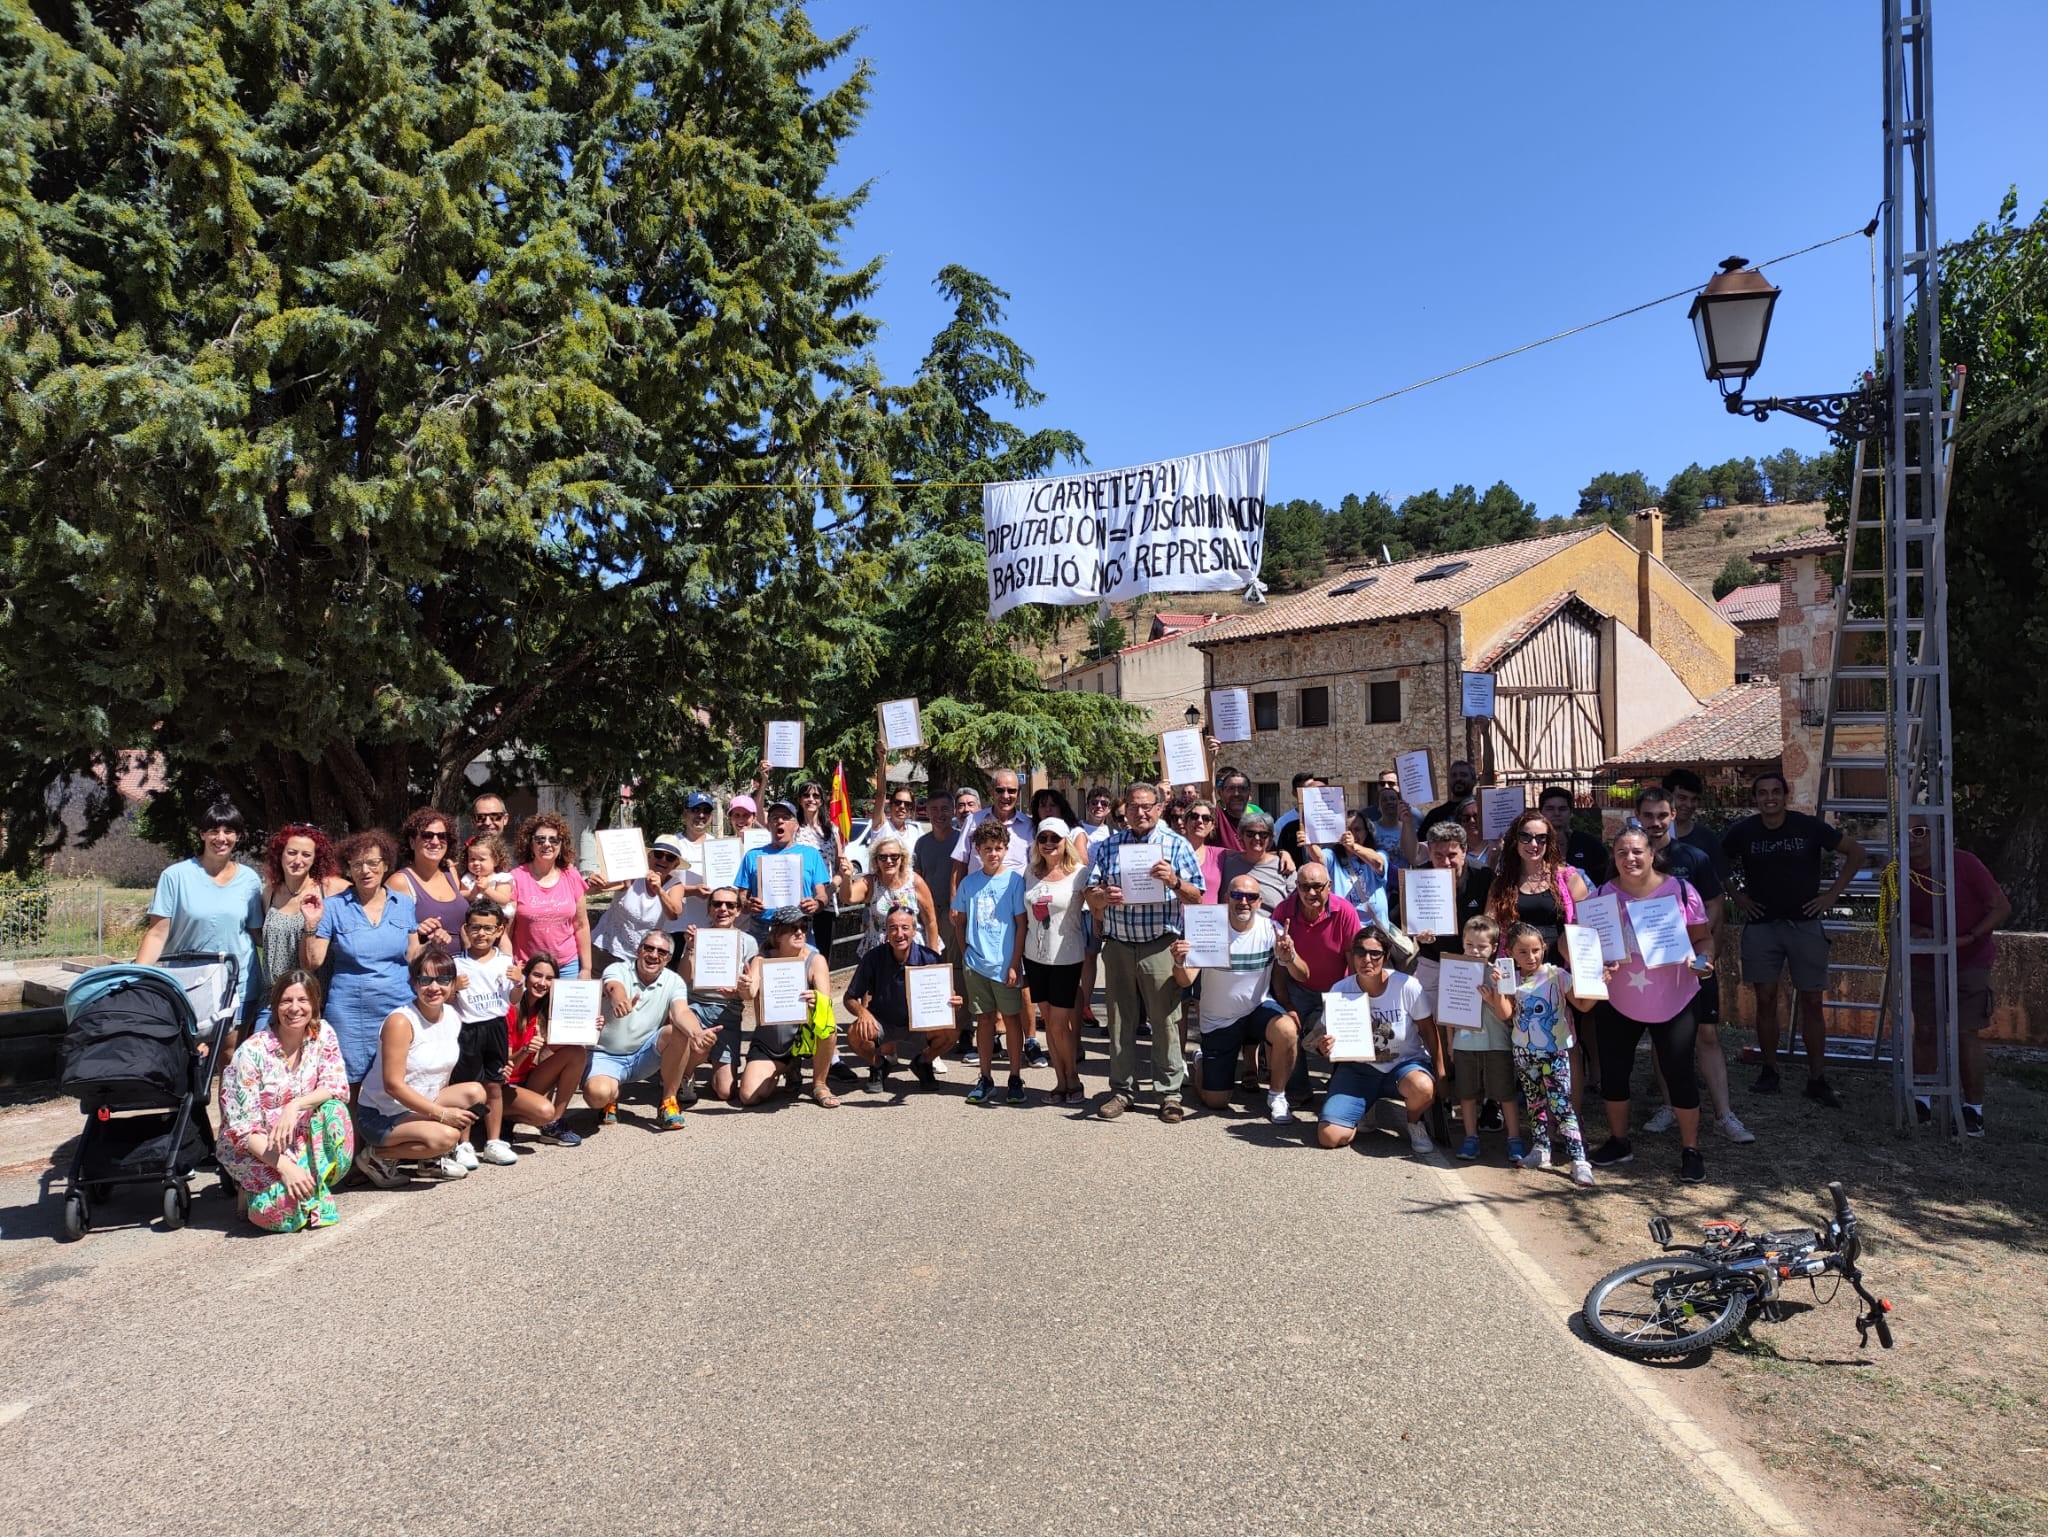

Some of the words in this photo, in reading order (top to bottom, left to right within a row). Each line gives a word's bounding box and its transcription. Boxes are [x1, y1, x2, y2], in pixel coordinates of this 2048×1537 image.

[1026, 465, 1177, 513] ¡CARRETERA!
[988, 515, 1106, 558] DIPUTACION
[1091, 552, 1126, 594] NOS
[1370, 1008, 1401, 1025] NNIE
